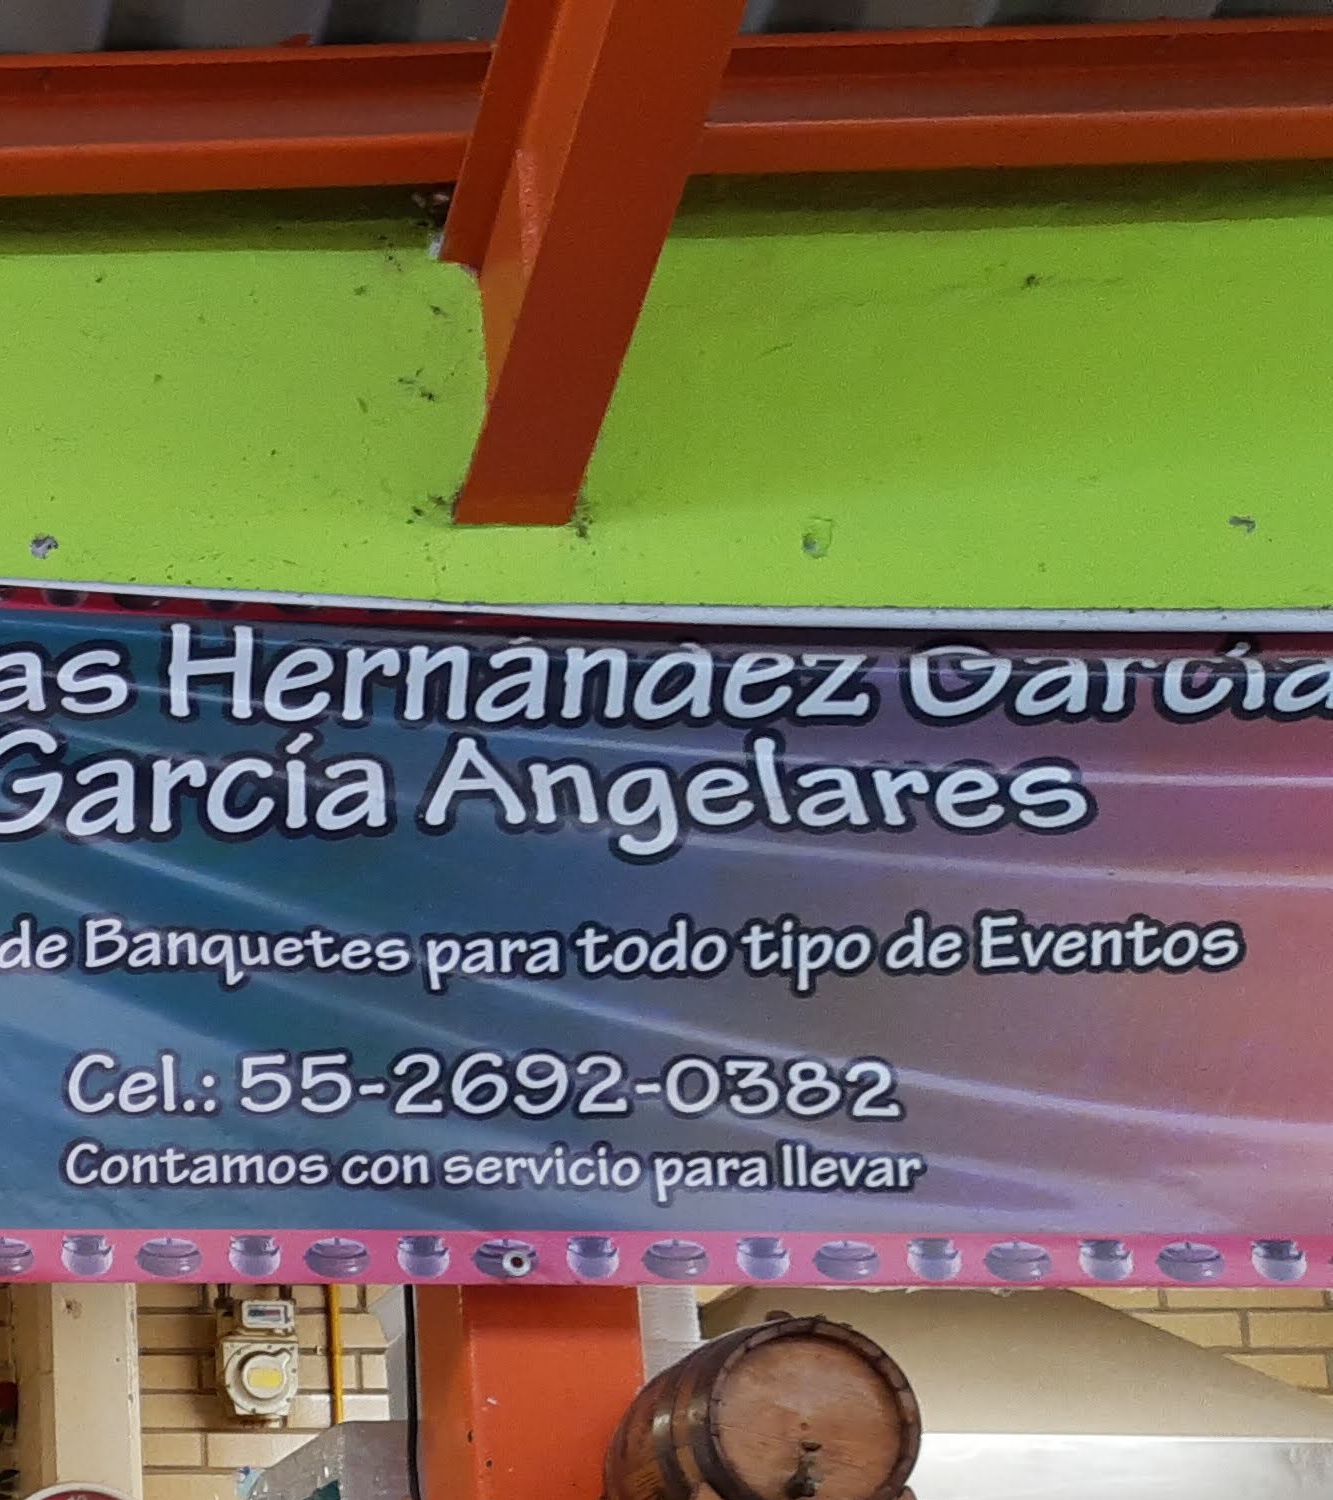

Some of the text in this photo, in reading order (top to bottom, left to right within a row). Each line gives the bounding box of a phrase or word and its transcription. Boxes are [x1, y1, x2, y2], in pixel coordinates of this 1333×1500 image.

[169, 622, 870, 722] Hernández
[425, 737, 1090, 855] Angelares
[85, 921, 411, 984] Banquetes
[428, 934, 561, 986] para
[578, 925, 727, 974] todo
[742, 921, 871, 990] tipo
[887, 919, 961, 969] de
[981, 916, 1241, 969] Eventos
[67, 1053, 901, 1117] Cel.: 55-2692-0382
[66, 1144, 922, 1199] Contamos con servicio para llevar
